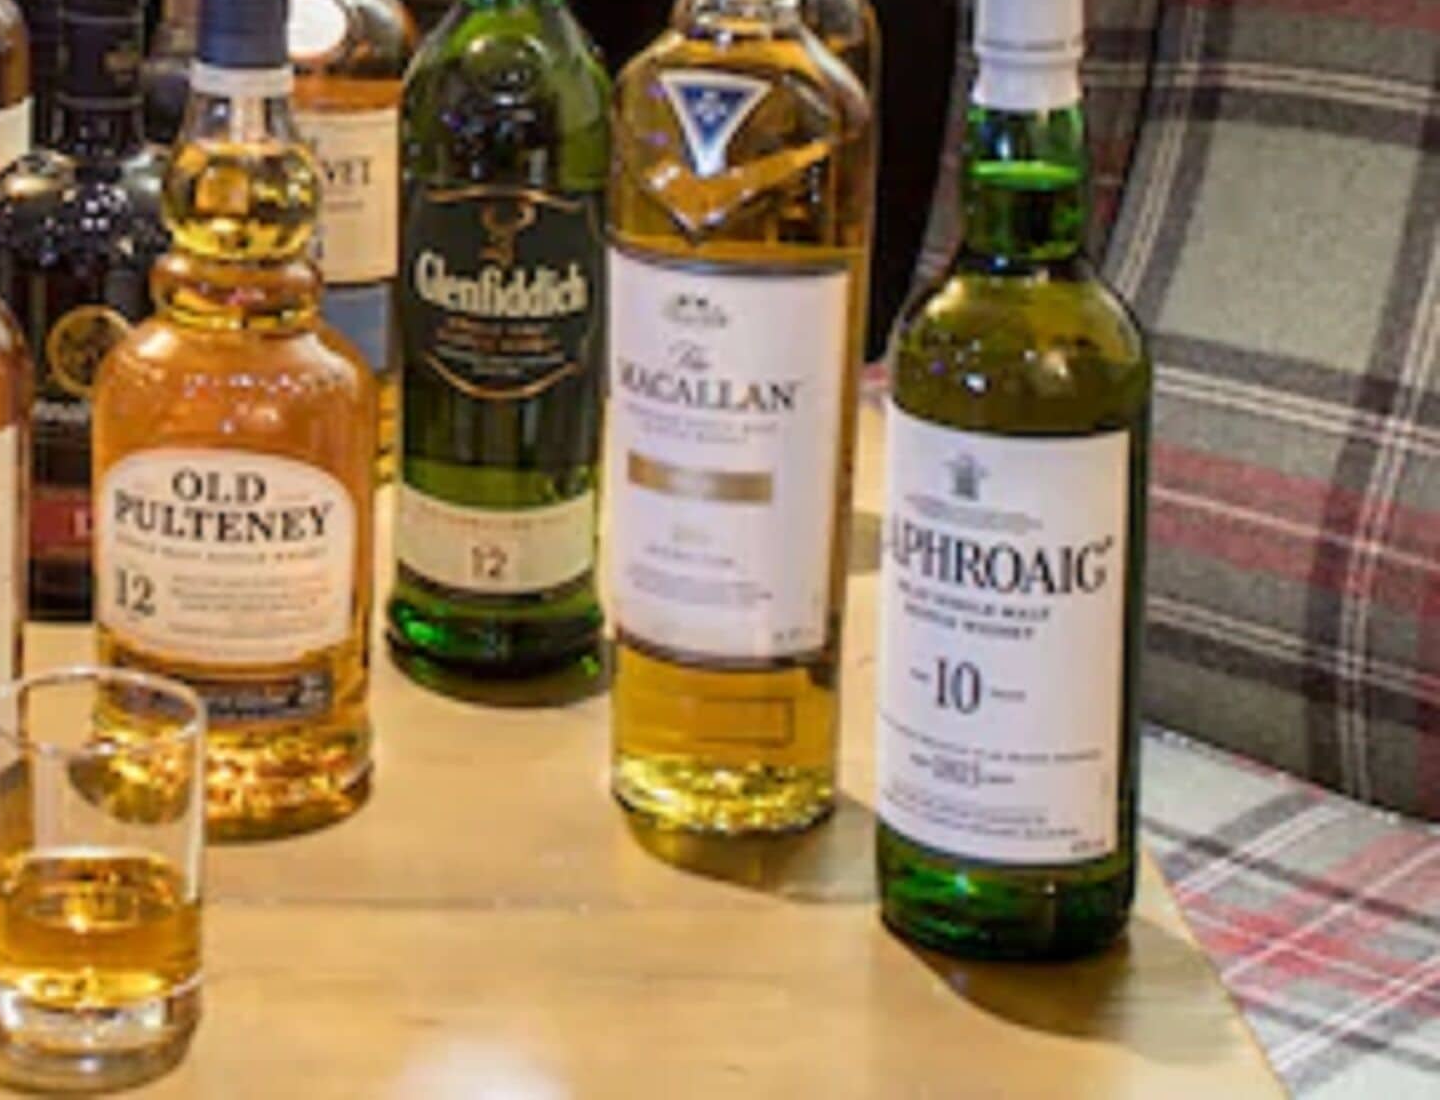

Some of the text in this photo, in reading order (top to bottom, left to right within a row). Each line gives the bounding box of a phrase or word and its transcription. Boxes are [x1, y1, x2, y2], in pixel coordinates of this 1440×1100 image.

[415, 250, 587, 318] Glenfiddich
[666, 339, 711, 373] The
[616, 356, 800, 412] MACALLAN
[171, 467, 267, 504] OLD
[113, 489, 334, 543] PULTENEY
[470, 544, 508, 578] 12
[114, 567, 156, 617] 12
[935, 656, 981, 715] 10
